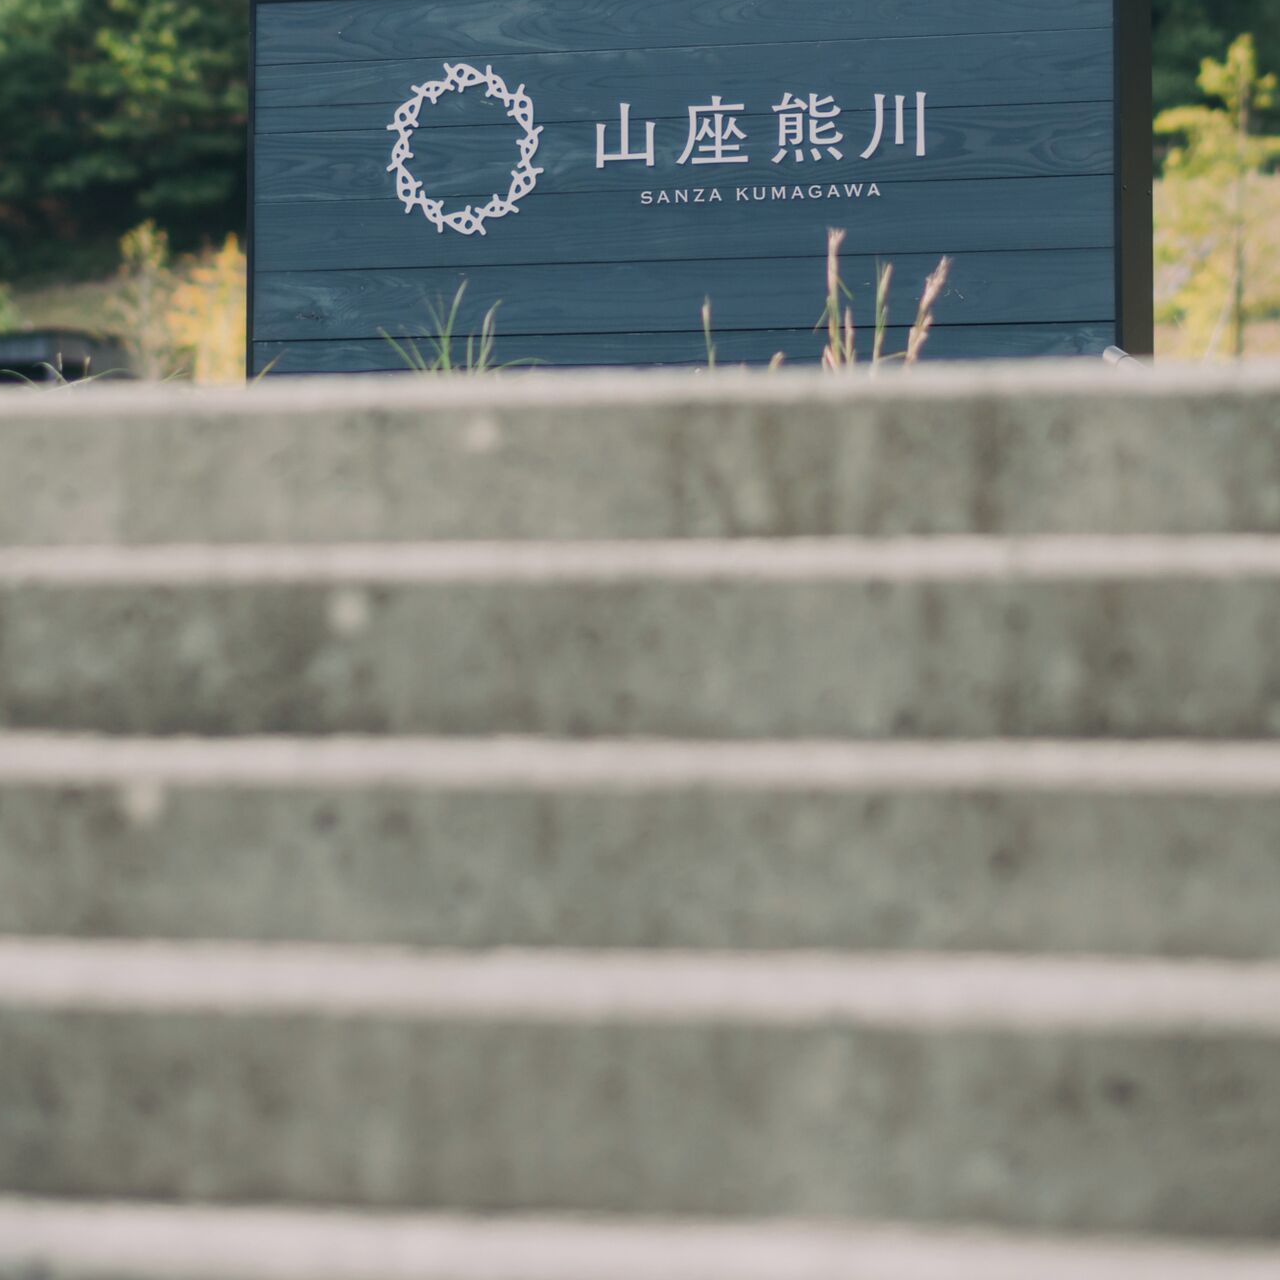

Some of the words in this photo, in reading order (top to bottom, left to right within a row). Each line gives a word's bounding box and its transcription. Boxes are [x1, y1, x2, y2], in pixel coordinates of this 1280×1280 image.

[595, 91, 927, 169] 山座熊川
[640, 187, 723, 205] SANZA
[735, 182, 881, 201] KUMAGAWA
